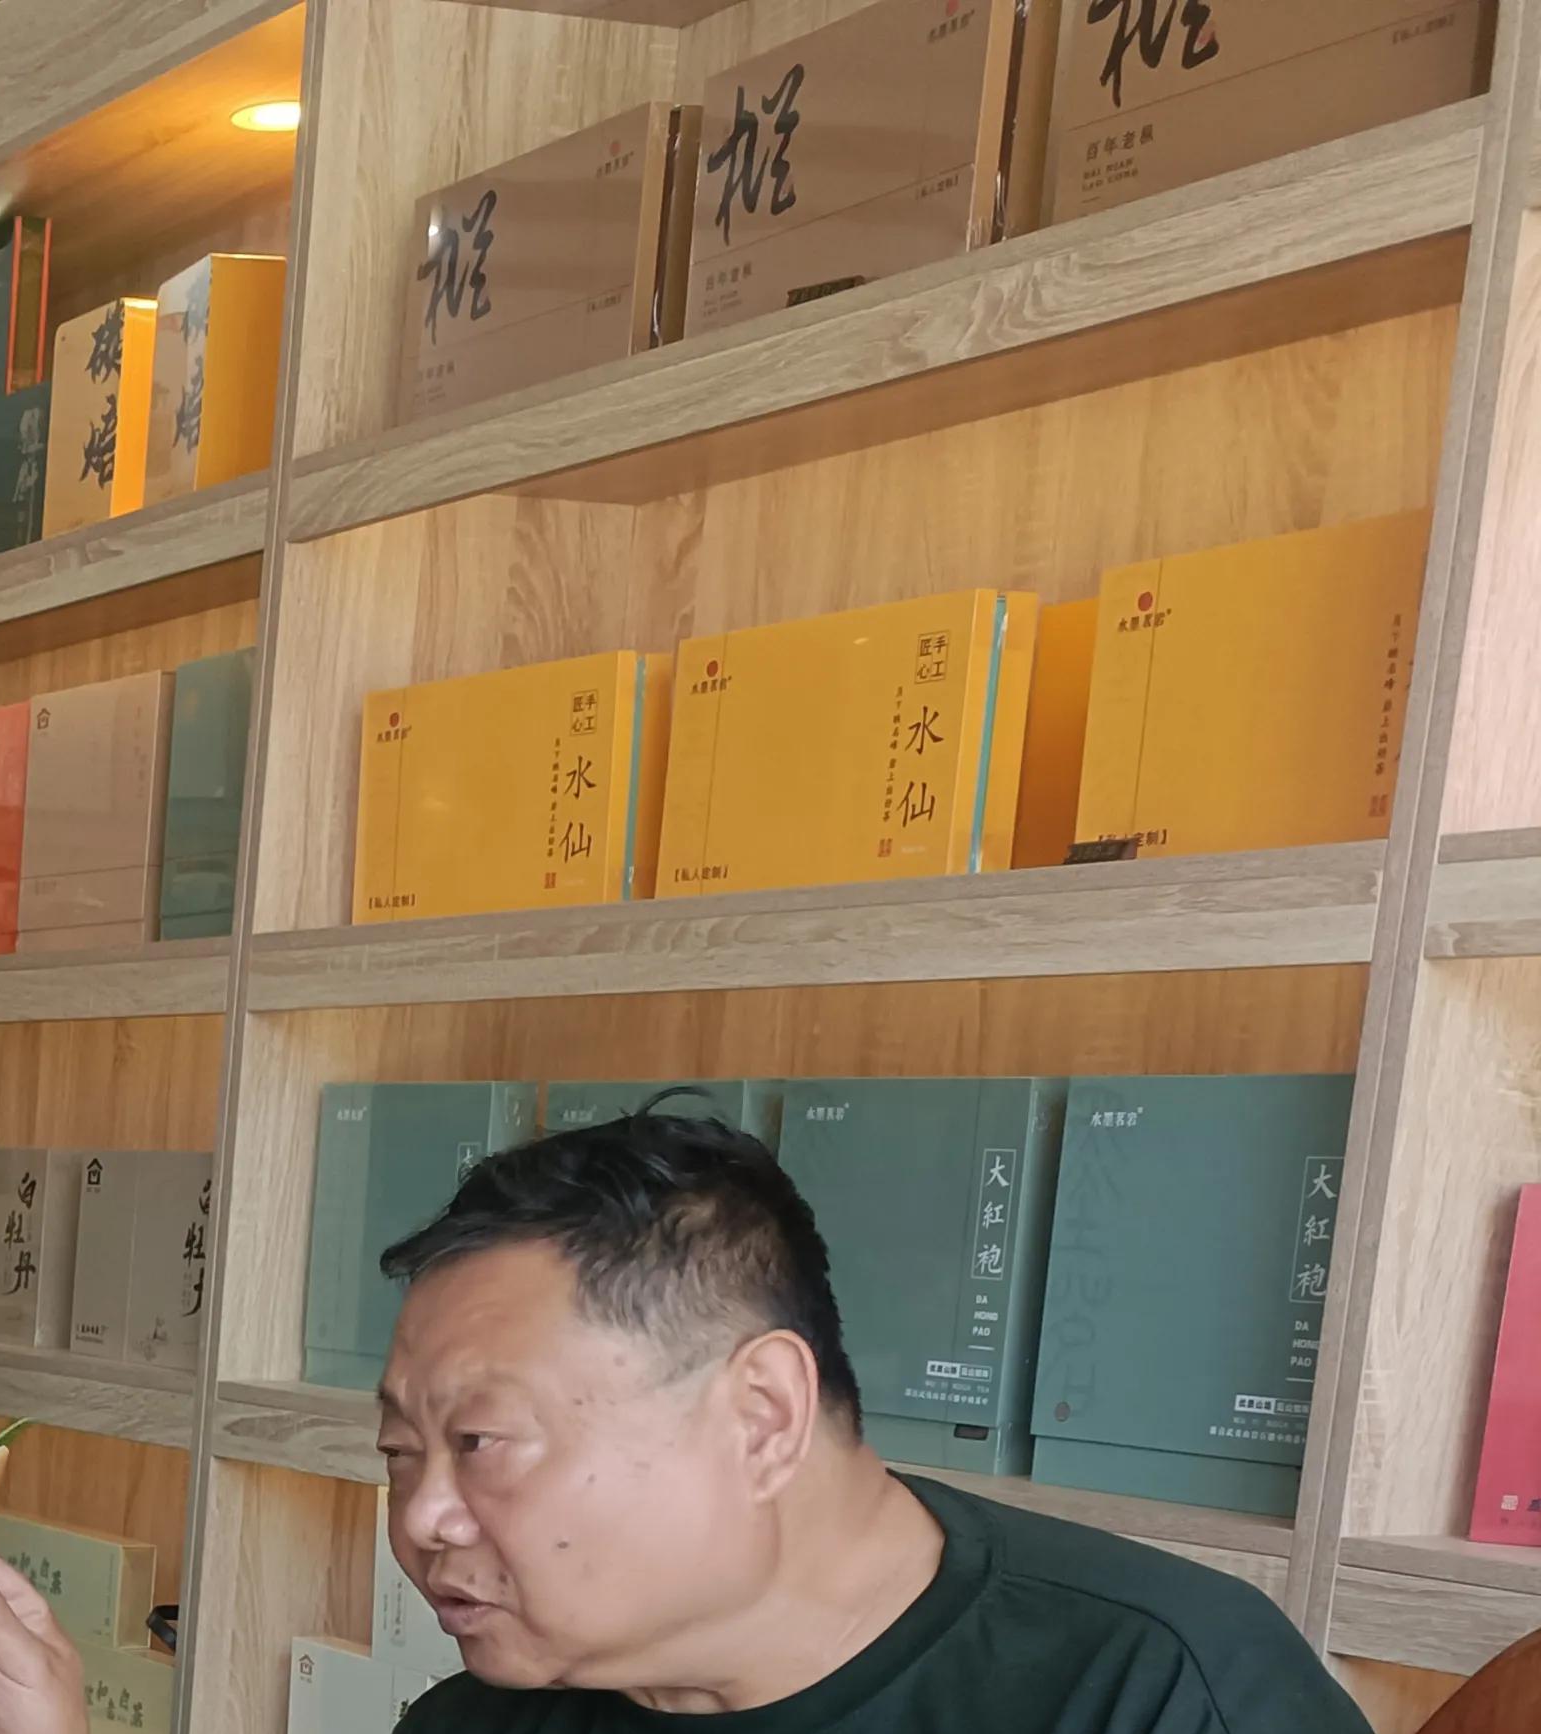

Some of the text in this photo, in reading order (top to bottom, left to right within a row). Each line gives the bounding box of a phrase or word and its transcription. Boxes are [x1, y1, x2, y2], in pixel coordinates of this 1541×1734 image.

[559, 755, 597, 863] 水仙
[895, 705, 945, 828] 水仙
[1090, 1111, 1138, 1128] 水墨茗岩
[3, 1172, 37, 1295] 白牡丹
[975, 1155, 1009, 1275] 大紅袍
[1296, 1164, 1338, 1298] 大紅袍
[1290, 1356, 1312, 1367] PAO
[1295, 1320, 1309, 1331] DA
